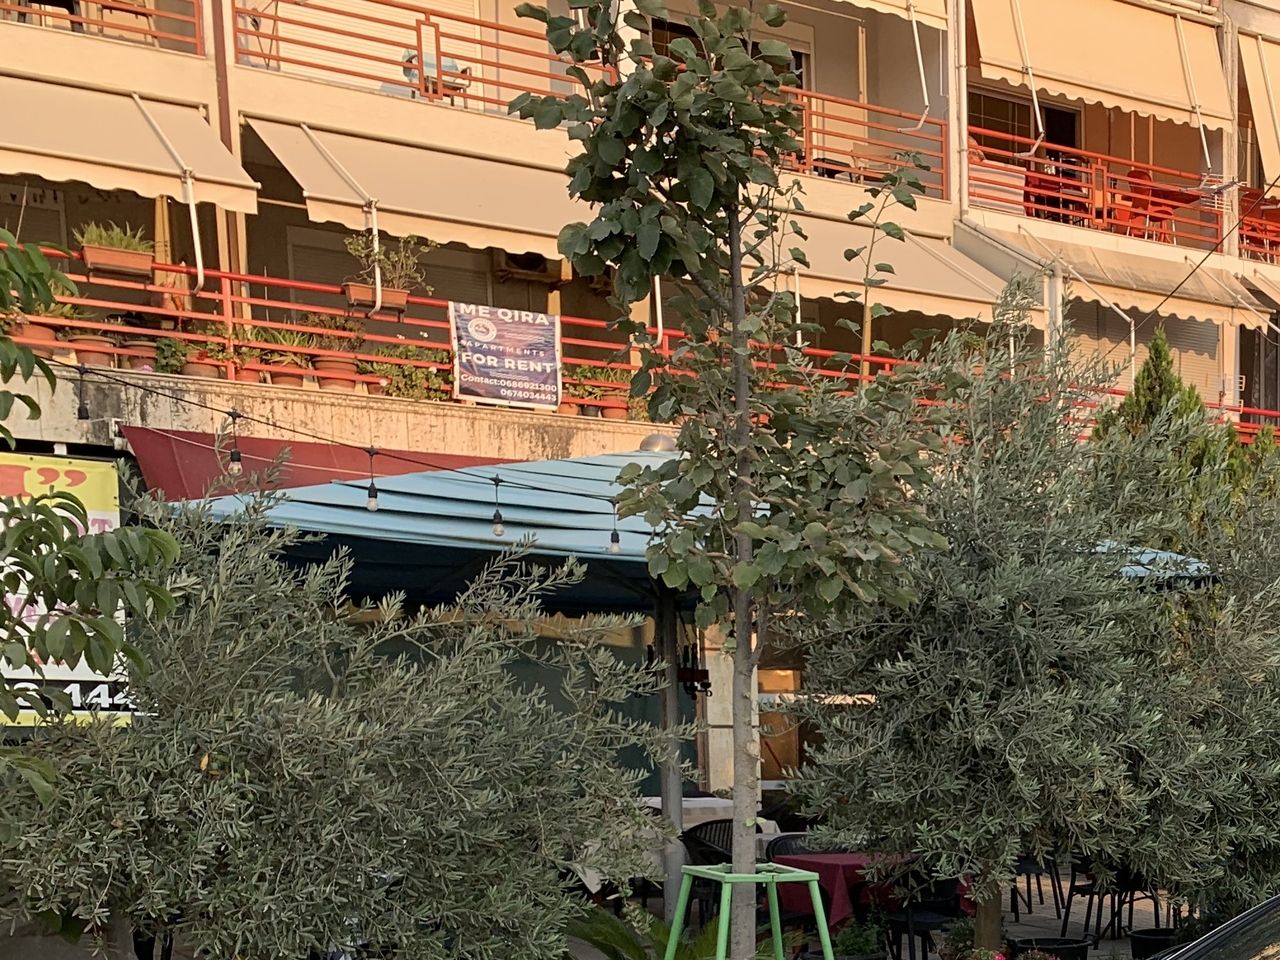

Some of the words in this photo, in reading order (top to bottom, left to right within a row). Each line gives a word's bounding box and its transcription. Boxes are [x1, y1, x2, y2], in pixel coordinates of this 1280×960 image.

[460, 303, 491, 318] ME
[497, 308, 549, 326] QIRA
[466, 341, 545, 357] APARTMENTS
[461, 352, 498, 367] FOR
[504, 359, 554, 374] RENT
